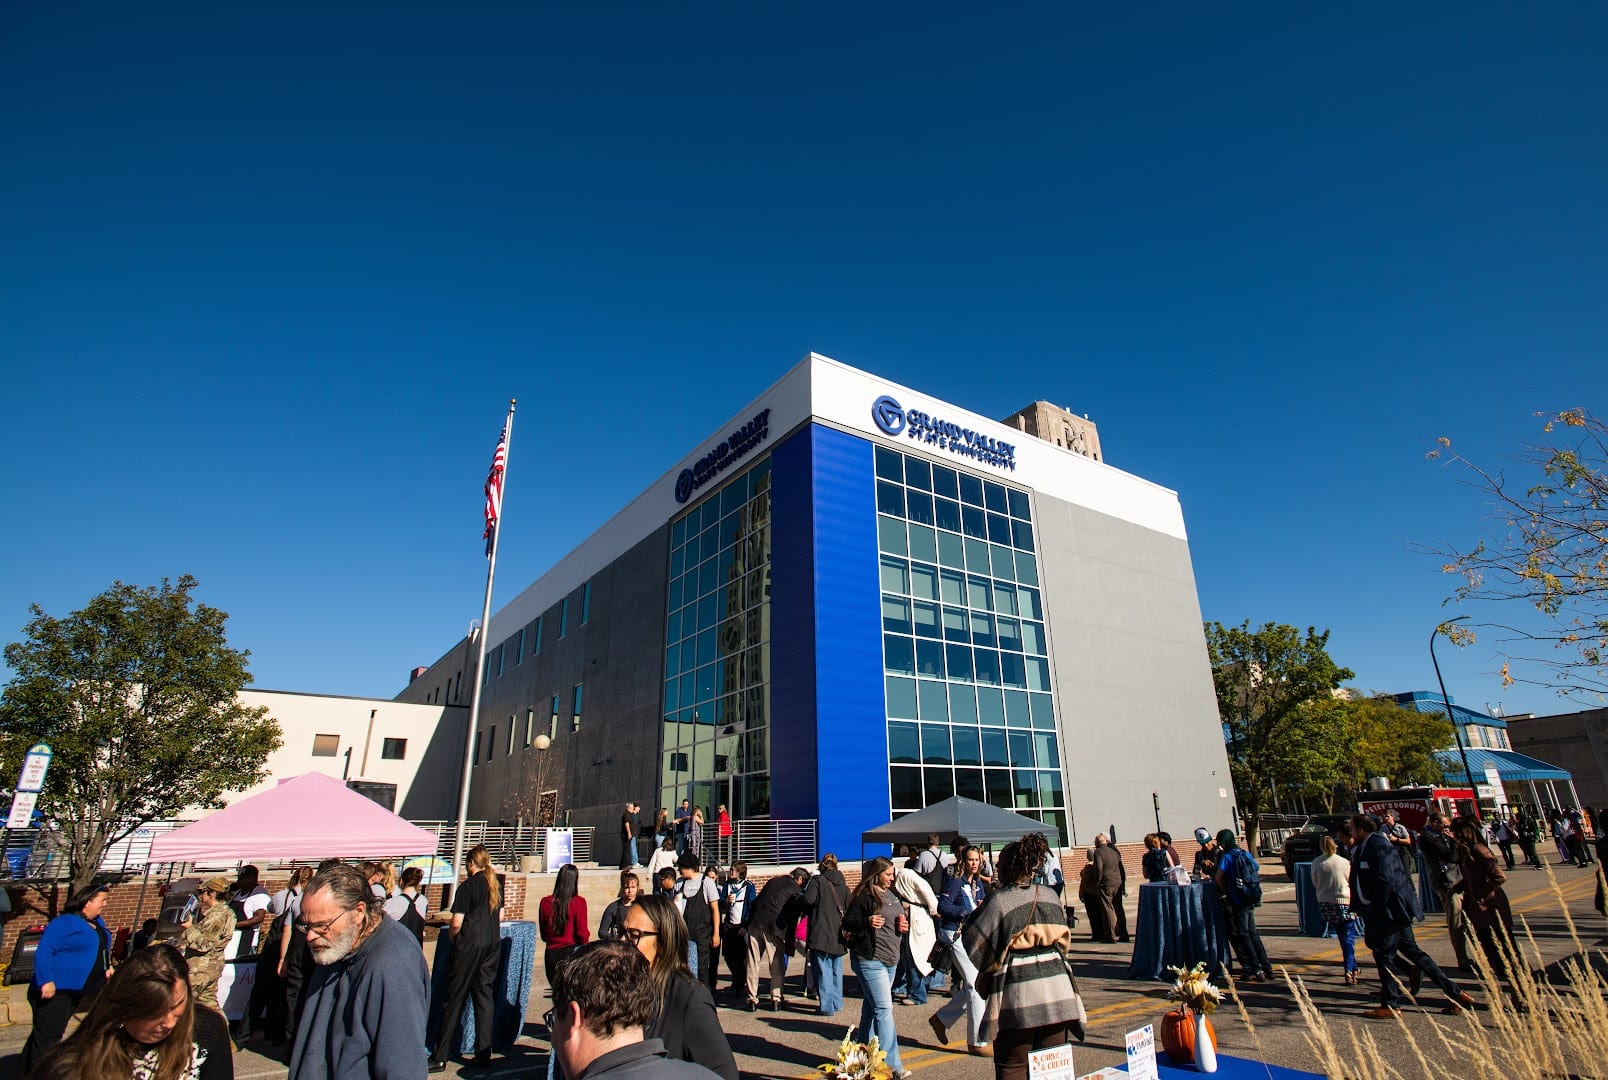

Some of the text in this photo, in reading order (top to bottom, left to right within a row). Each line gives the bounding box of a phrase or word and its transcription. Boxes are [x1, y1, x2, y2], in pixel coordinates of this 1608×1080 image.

[692, 427, 768, 490] STATE UNIVERSITY
[693, 408, 770, 477] GRAND VALLEY
[906, 408, 1016, 460] GRAND VALLEY
[907, 425, 1017, 472] STATE UNIVERSITY
[1394, 802, 1426, 813] DONUTS
[1047, 1059, 1070, 1070] CREATE
